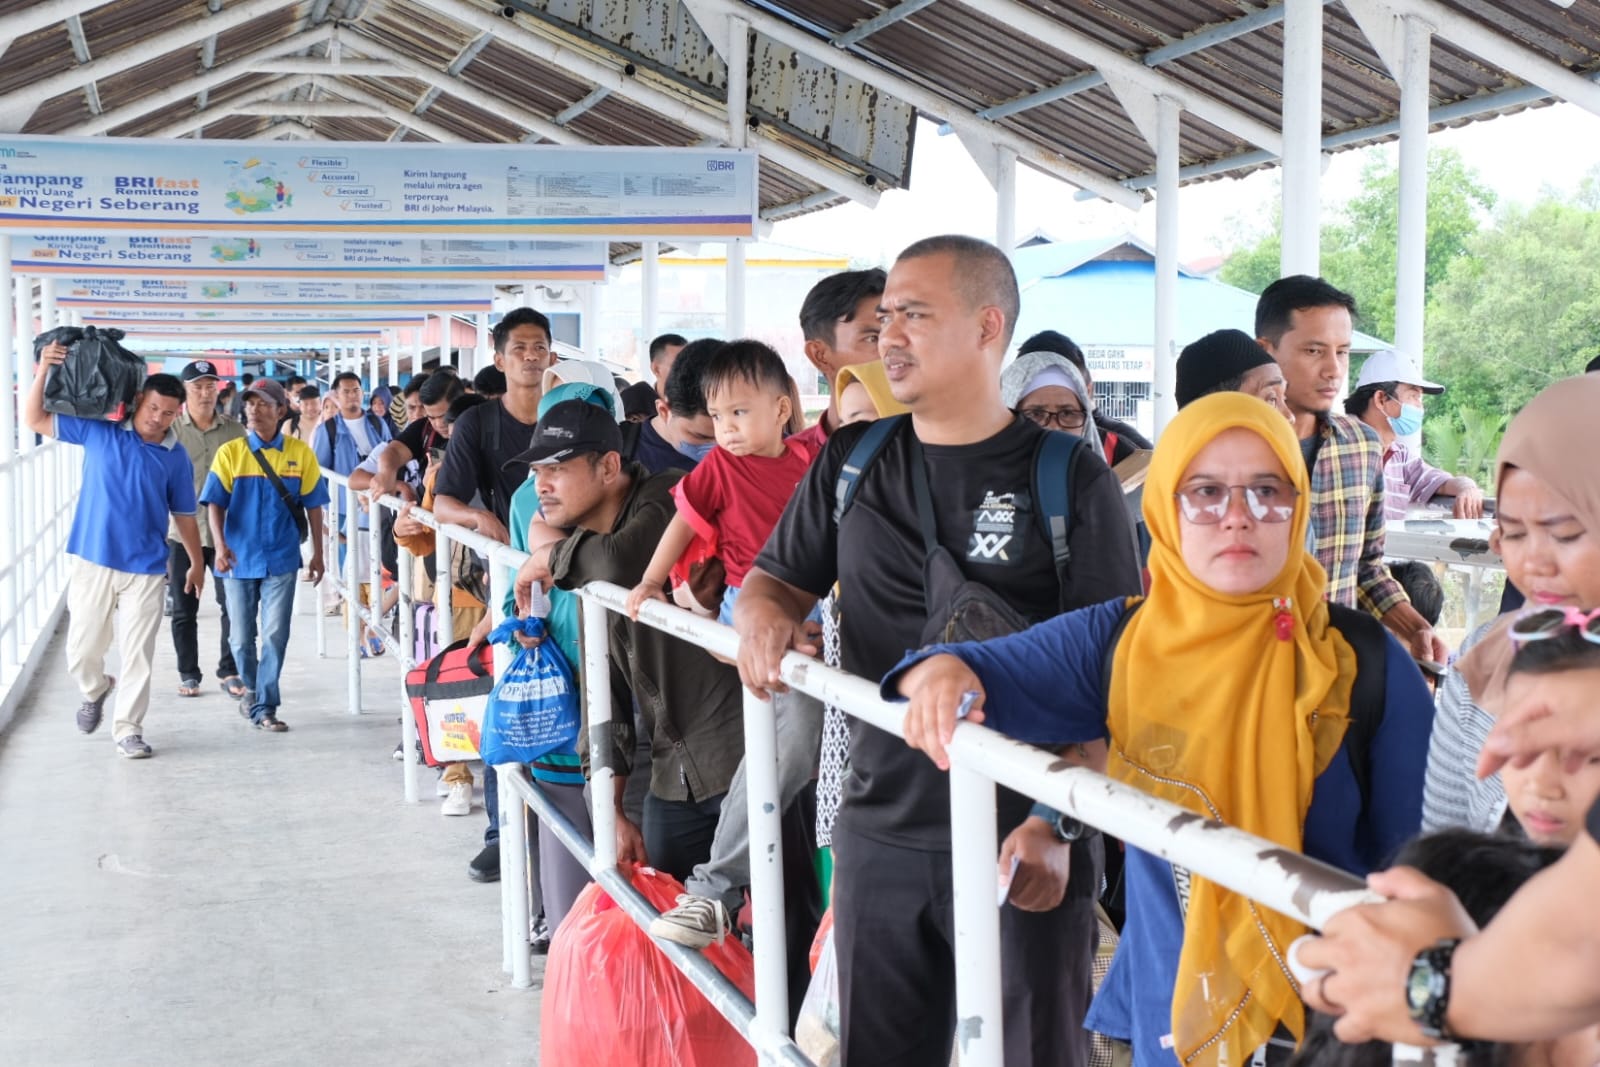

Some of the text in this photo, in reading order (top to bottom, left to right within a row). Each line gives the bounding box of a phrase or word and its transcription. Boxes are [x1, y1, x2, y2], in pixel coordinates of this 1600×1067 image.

[312, 159, 342, 167] Flexible
[718, 160, 735, 171] BRI
[403, 170, 467, 180] Kirim langsung
[0, 174, 84, 189] ampang
[115, 176, 199, 188] BRIfast
[403, 181, 482, 192] melalui mitra agen
[4, 187, 74, 198] Kirim Uang
[115, 187, 199, 196] Remittance
[403, 193, 448, 202] terpercaya
[20, 196, 92, 212] Negeri
[100, 197, 199, 214] Seberang
[404, 203, 420, 212] BRI
[422, 204, 430, 212] di
[431, 204, 455, 213] Johor
[58, 250, 112, 261] Negeri
[118, 250, 191, 263] Seberang
